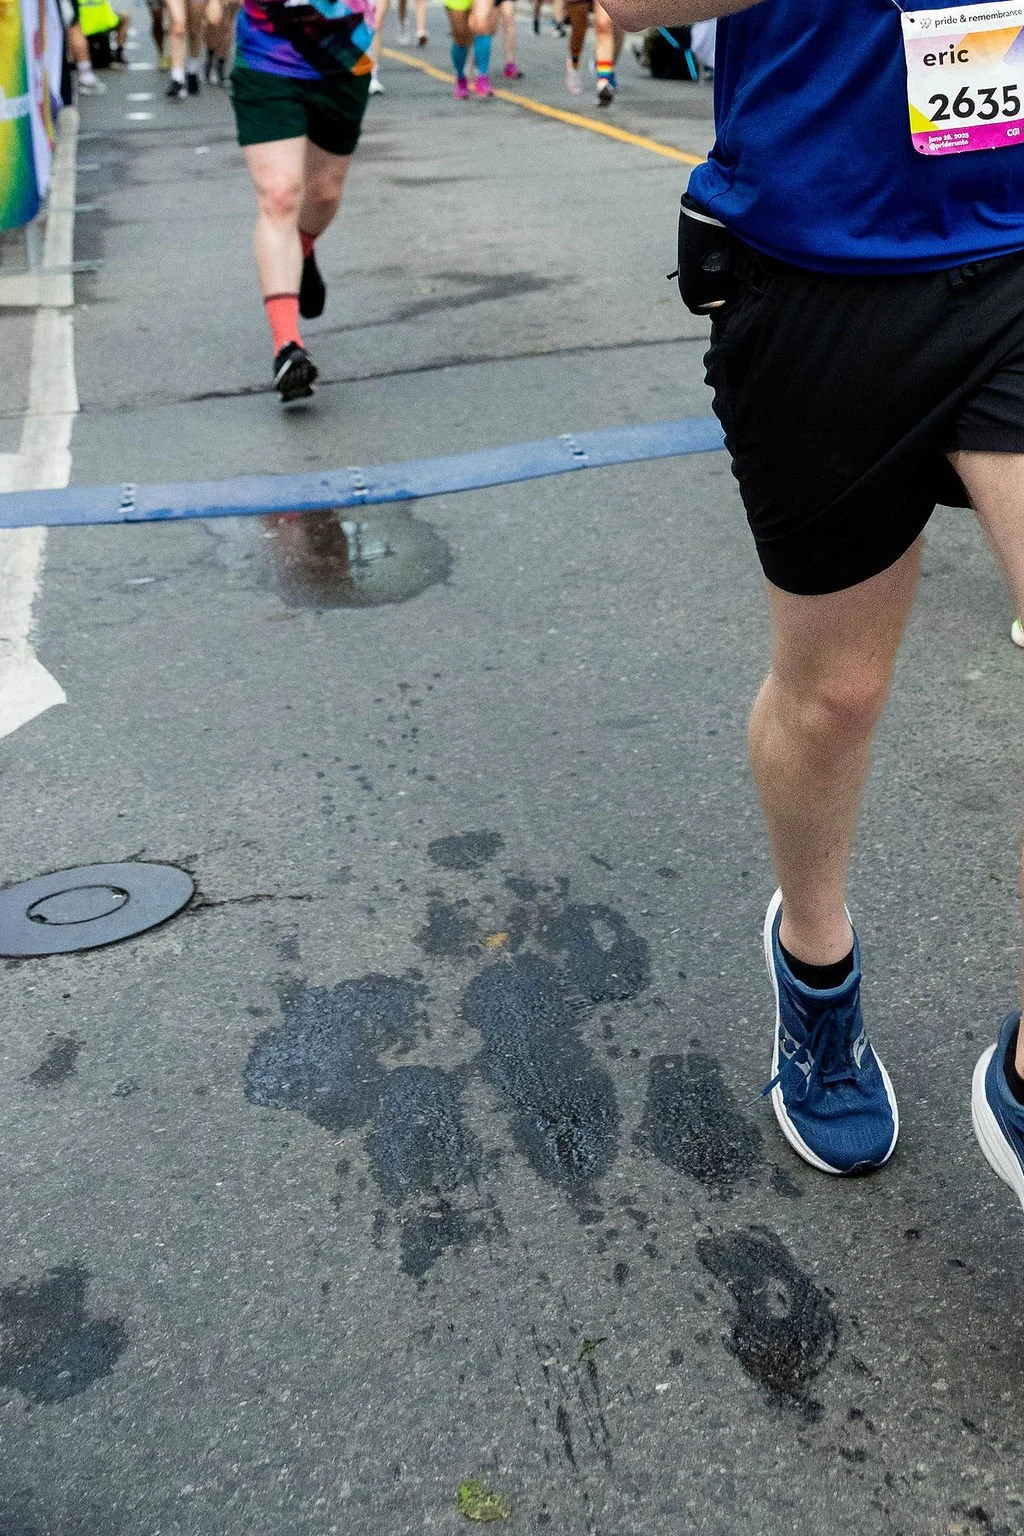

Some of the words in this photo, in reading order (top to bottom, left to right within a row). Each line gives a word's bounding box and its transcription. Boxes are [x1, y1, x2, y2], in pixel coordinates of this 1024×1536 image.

[934, 14, 958, 28] pride
[960, 14, 968, 23] &
[968, 9, 1023, 23] remembrance
[923, 44, 969, 67] eric
[928, 84, 1021, 122] 2635
[1006, 127, 1020, 137] CGI
